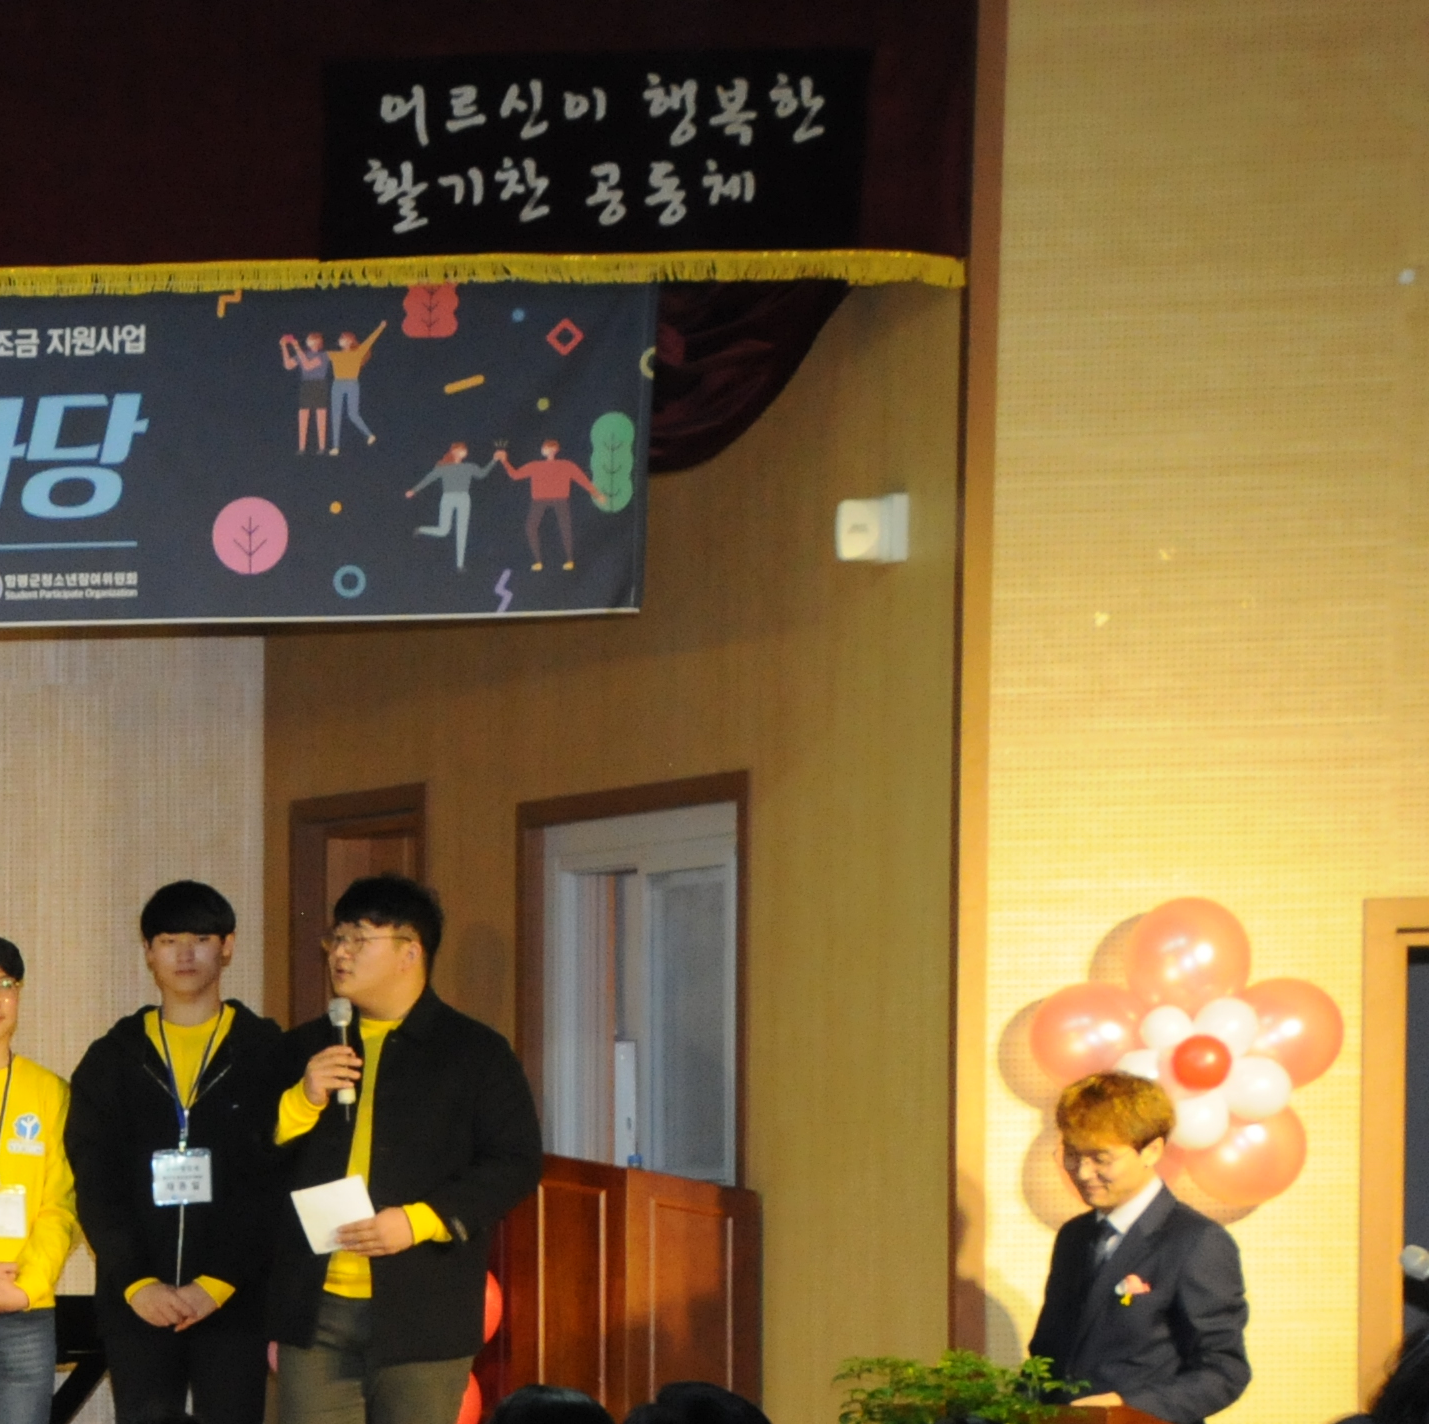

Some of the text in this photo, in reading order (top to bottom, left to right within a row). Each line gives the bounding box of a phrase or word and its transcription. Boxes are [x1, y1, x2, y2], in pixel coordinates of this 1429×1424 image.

[380, 72, 826, 147] 어르신이 행복한
[363, 157, 756, 234] 활기찬 공동체
[46, 324, 146, 356] 지원사업
